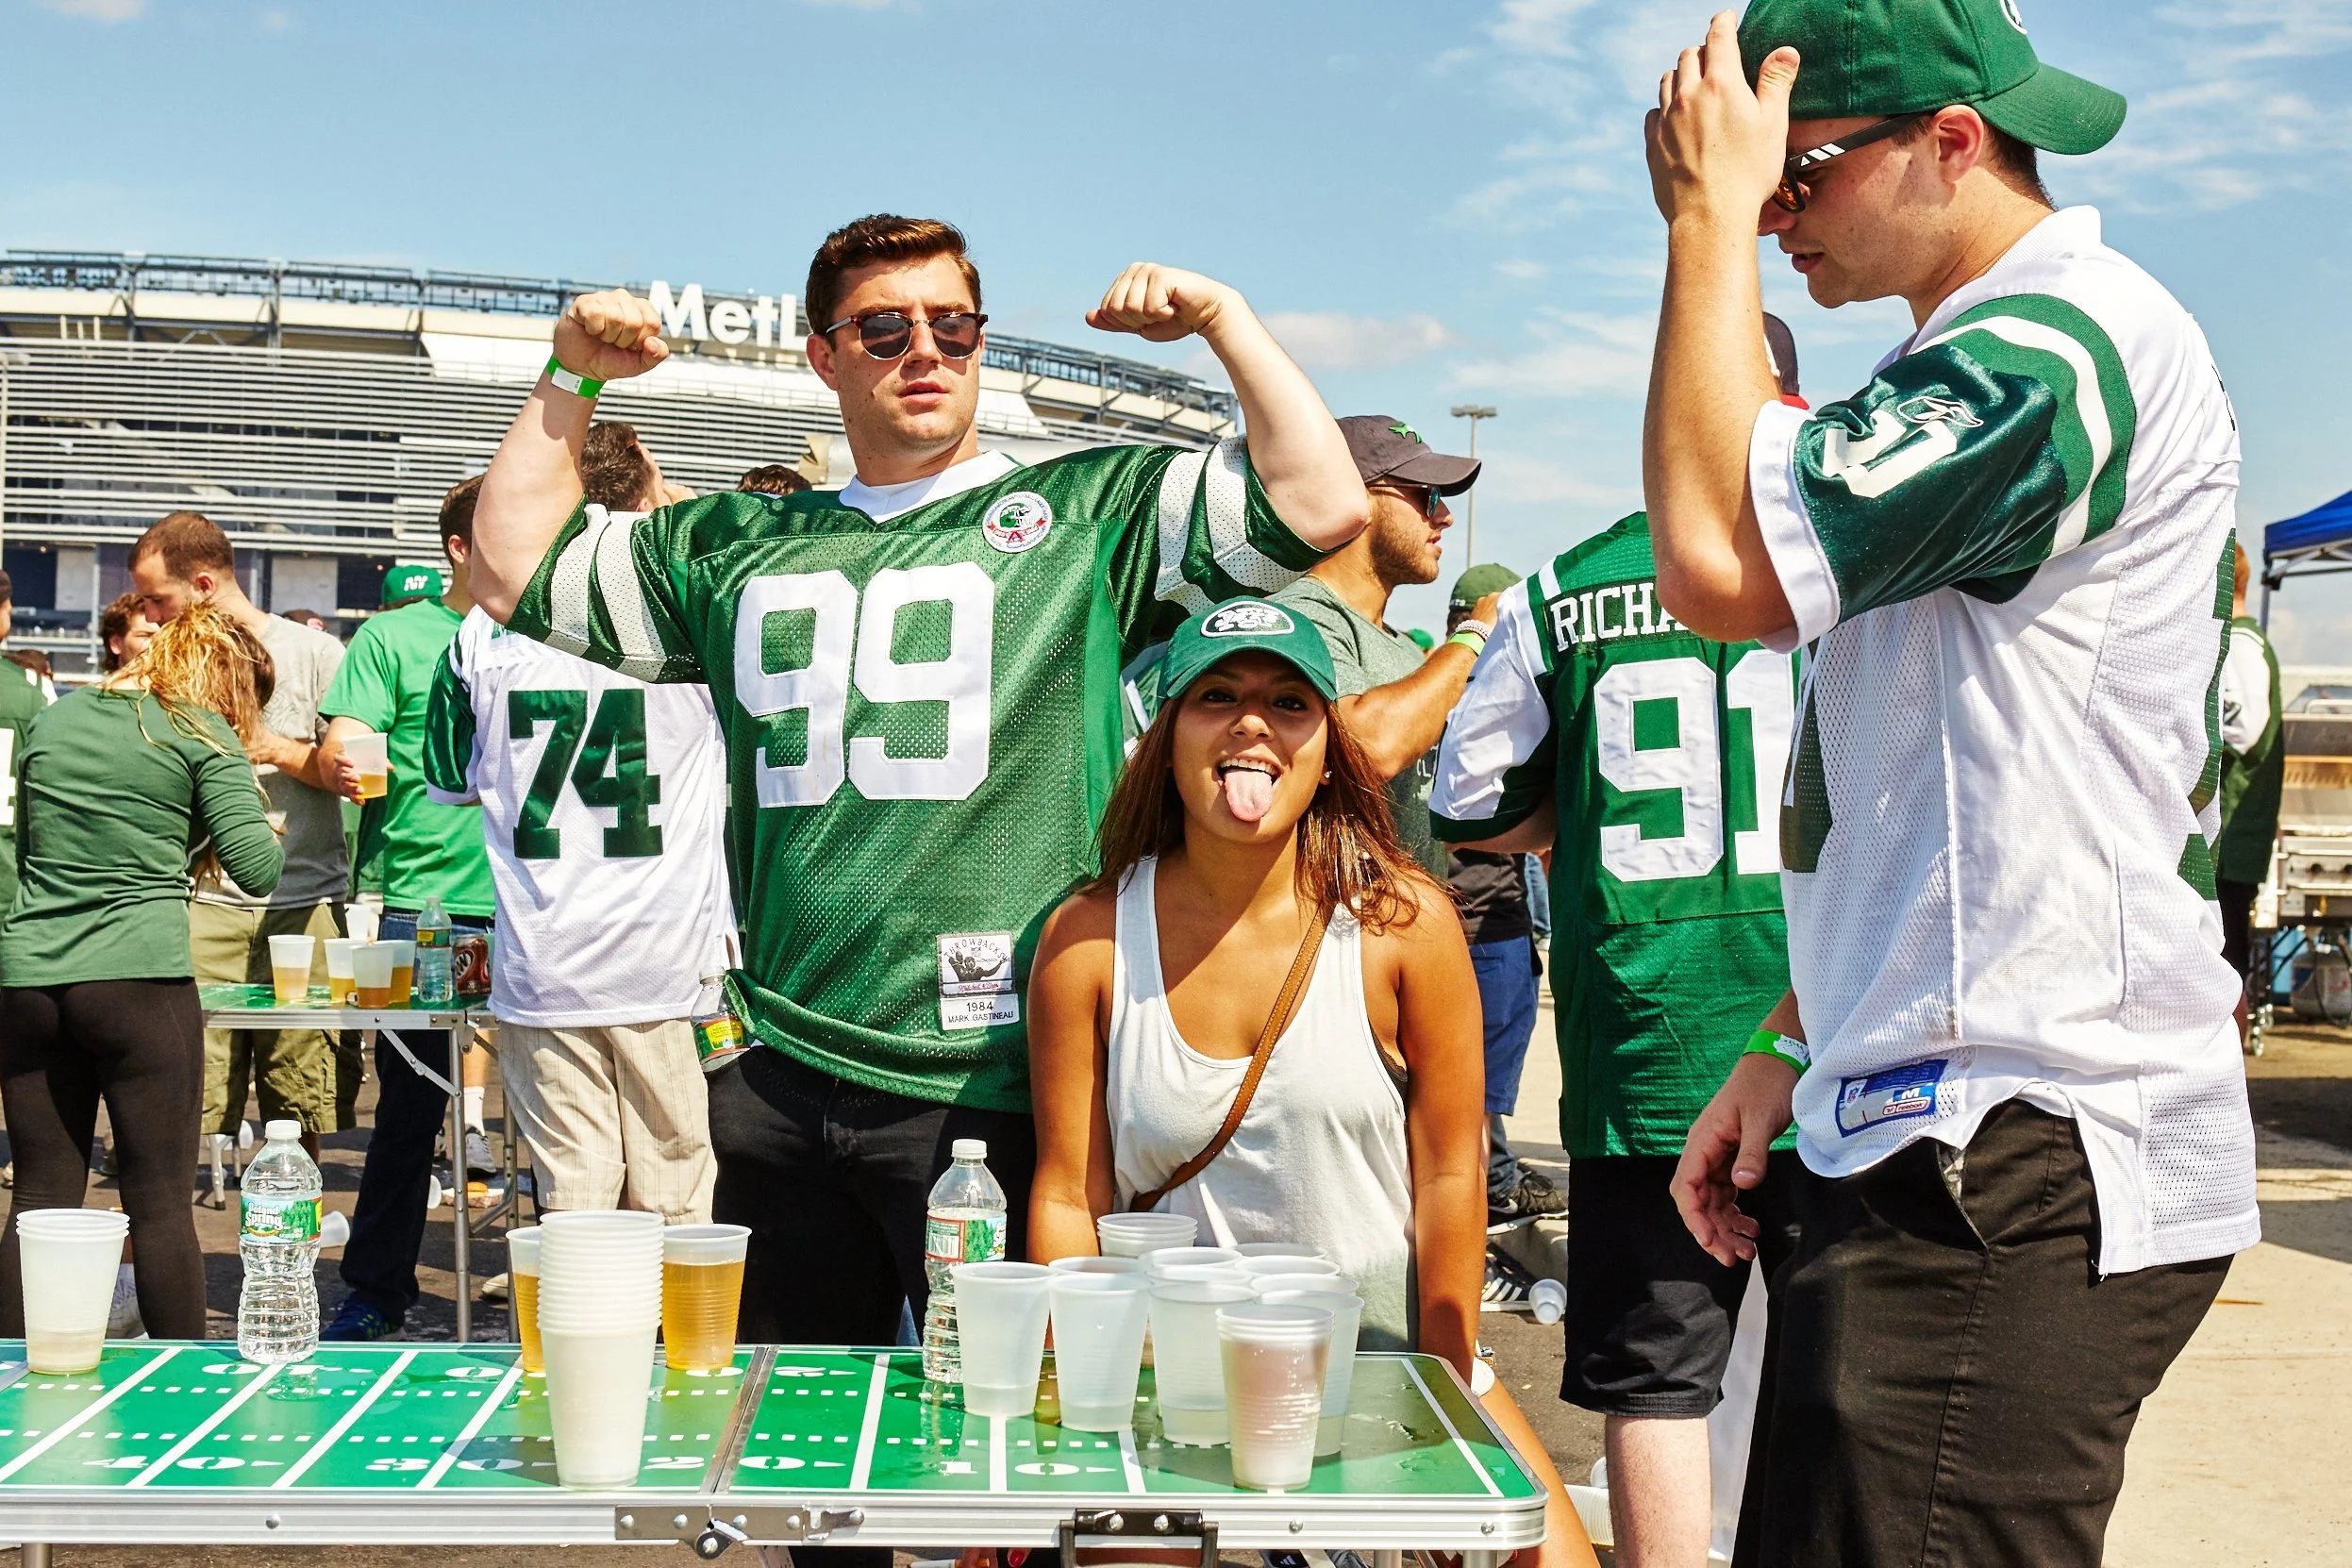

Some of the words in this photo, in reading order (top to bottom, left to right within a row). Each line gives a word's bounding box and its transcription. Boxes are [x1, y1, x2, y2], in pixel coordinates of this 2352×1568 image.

[734, 561, 994, 809] 99
[508, 689, 662, 859] 74
[1593, 649, 1793, 882] 91
[943, 938, 1007, 961] THROWBACKS
[966, 1000, 993, 1012] 1984
[947, 1014, 969, 1024] MARK
[972, 1010, 1014, 1022] GASTINEAU
[1901, 1088, 1920, 1101] M
[248, 1202, 280, 1215] Poland
[244, 1210, 283, 1231] Spring
